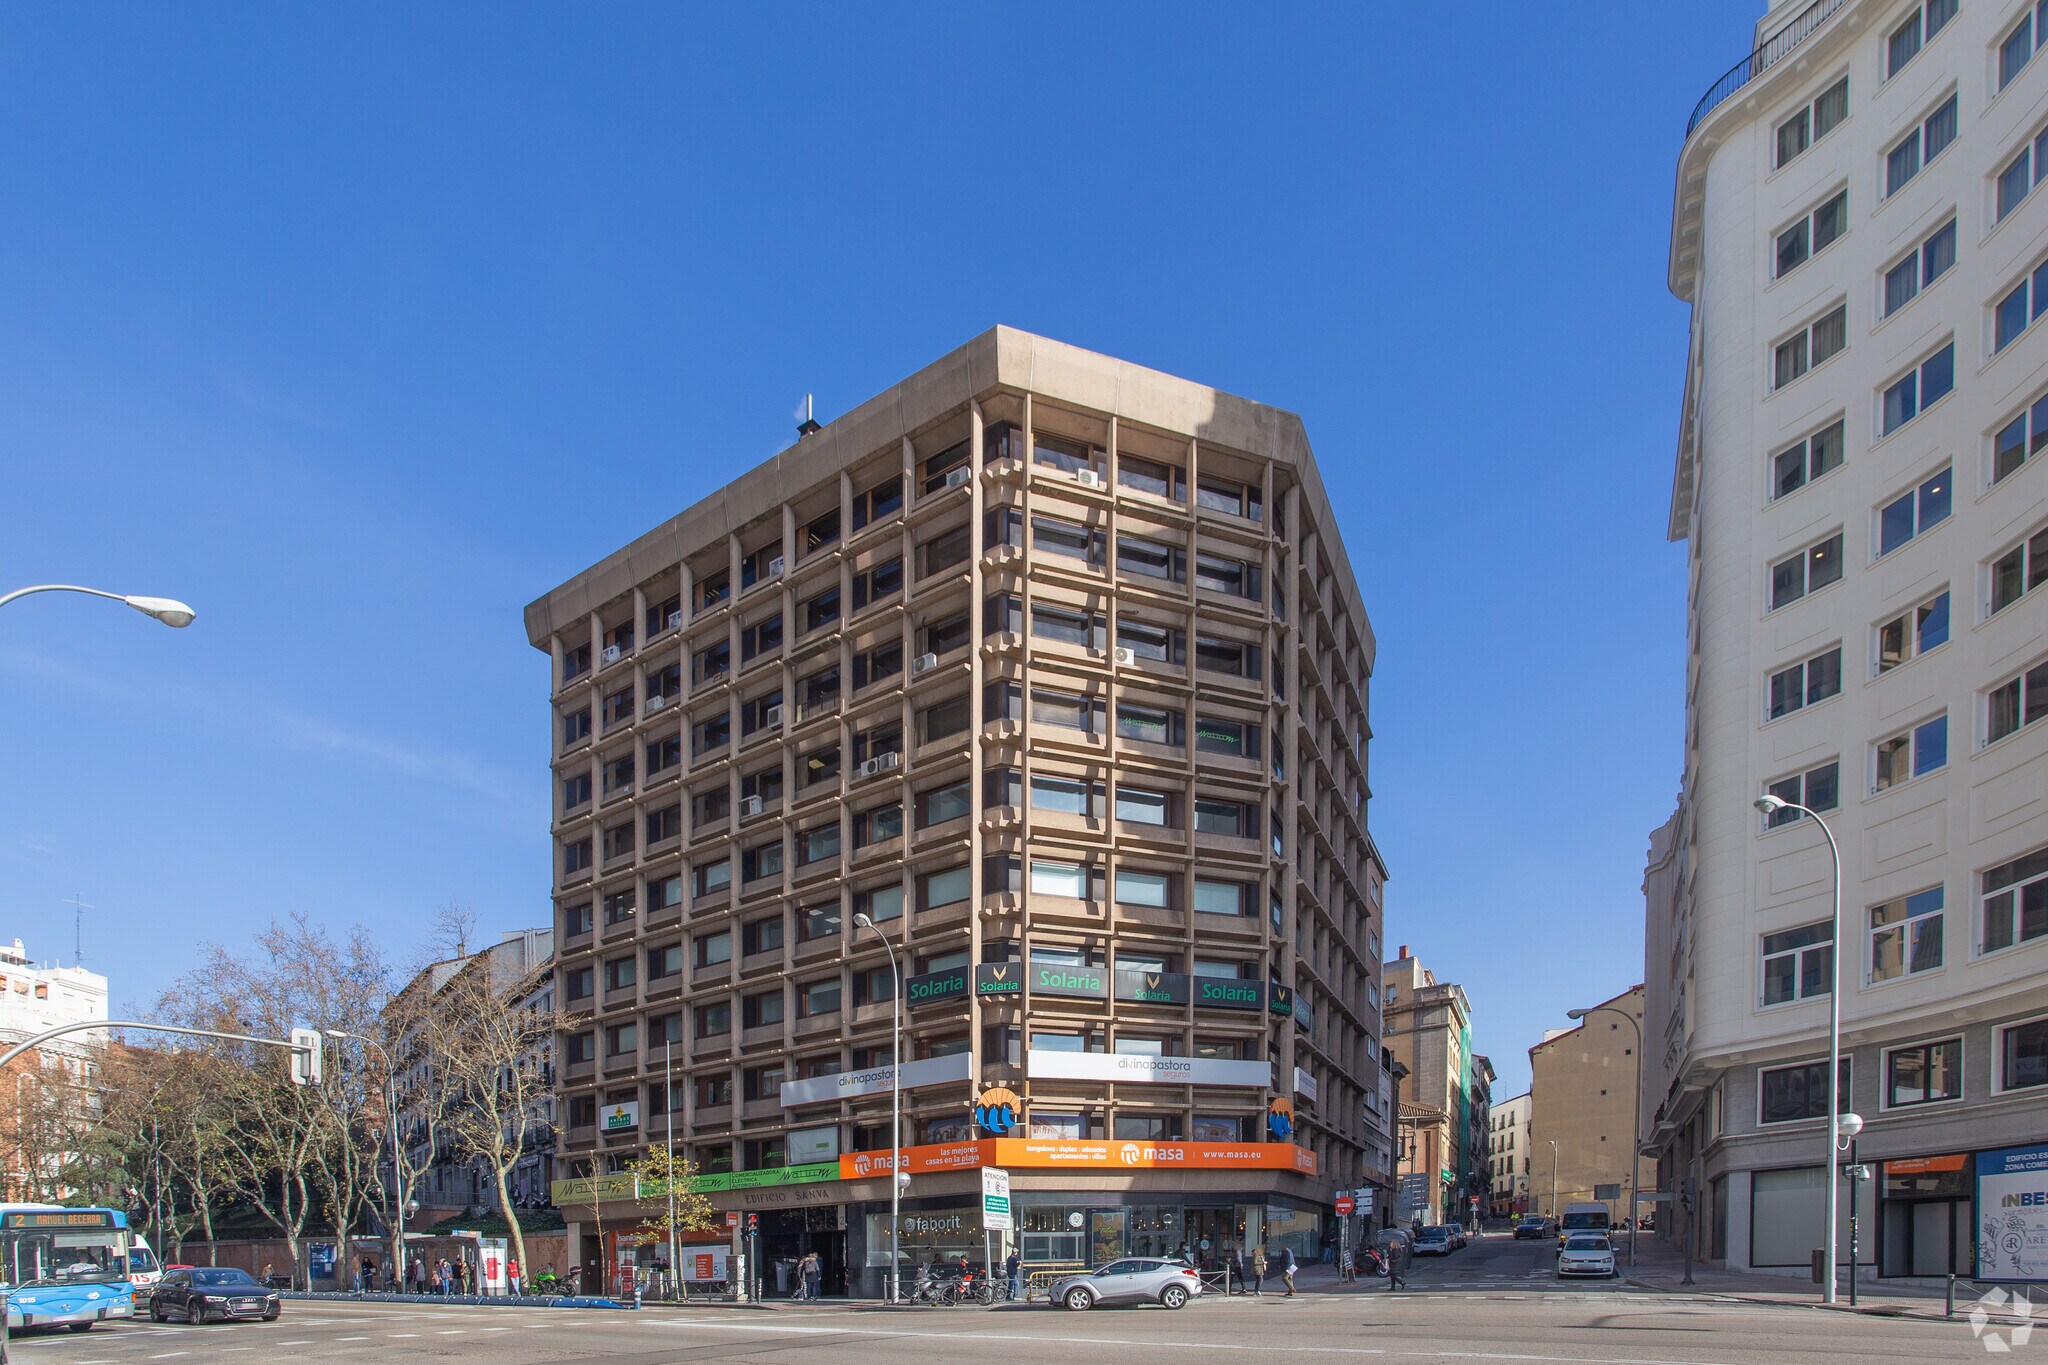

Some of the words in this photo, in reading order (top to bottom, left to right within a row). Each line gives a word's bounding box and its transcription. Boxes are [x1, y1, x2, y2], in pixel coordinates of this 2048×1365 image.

[980, 980, 1018, 992] Solaria
[1040, 970, 1100, 990] Solaria
[910, 975, 963, 999] Solaria
[1202, 983, 1256, 1002] Solaria
[1134, 988, 1171, 1001] Solaria
[1271, 1000, 1291, 1013] Solaria
[1118, 1058, 1191, 1072] divinapastora
[1163, 1071, 1191, 1079] seguros
[940, 1148, 951, 1156] las
[951, 1146, 978, 1155] mejores
[1026, 1145, 1056, 1153] bungalows
[1058, 1145, 1077, 1153] duplex
[1143, 1147, 1184, 1161] masa
[1203, 1151, 1261, 1159] www.masa.eu
[925, 1158, 944, 1166] casas
[953, 1154, 961, 1164] la
[961, 1153, 980, 1164] playa
[1050, 1153, 1089, 1161] apartamentos
[2006, 1153, 2037, 1163] EDIFICIO
[2004, 1163, 2025, 1171] ZONA
[731, 1169, 780, 1179] COMERCIALIZADORA
[745, 1192, 786, 1205] EDIFICIO
[796, 1189, 829, 1201] SANVA
[2001, 1191, 2048, 1207] INBE
[15, 1215, 25, 1227] 2
[36, 1215, 66, 1225] MANUEL
[68, 1214, 101, 1225] BECERRA
[916, 1215, 961, 1231] faborit
